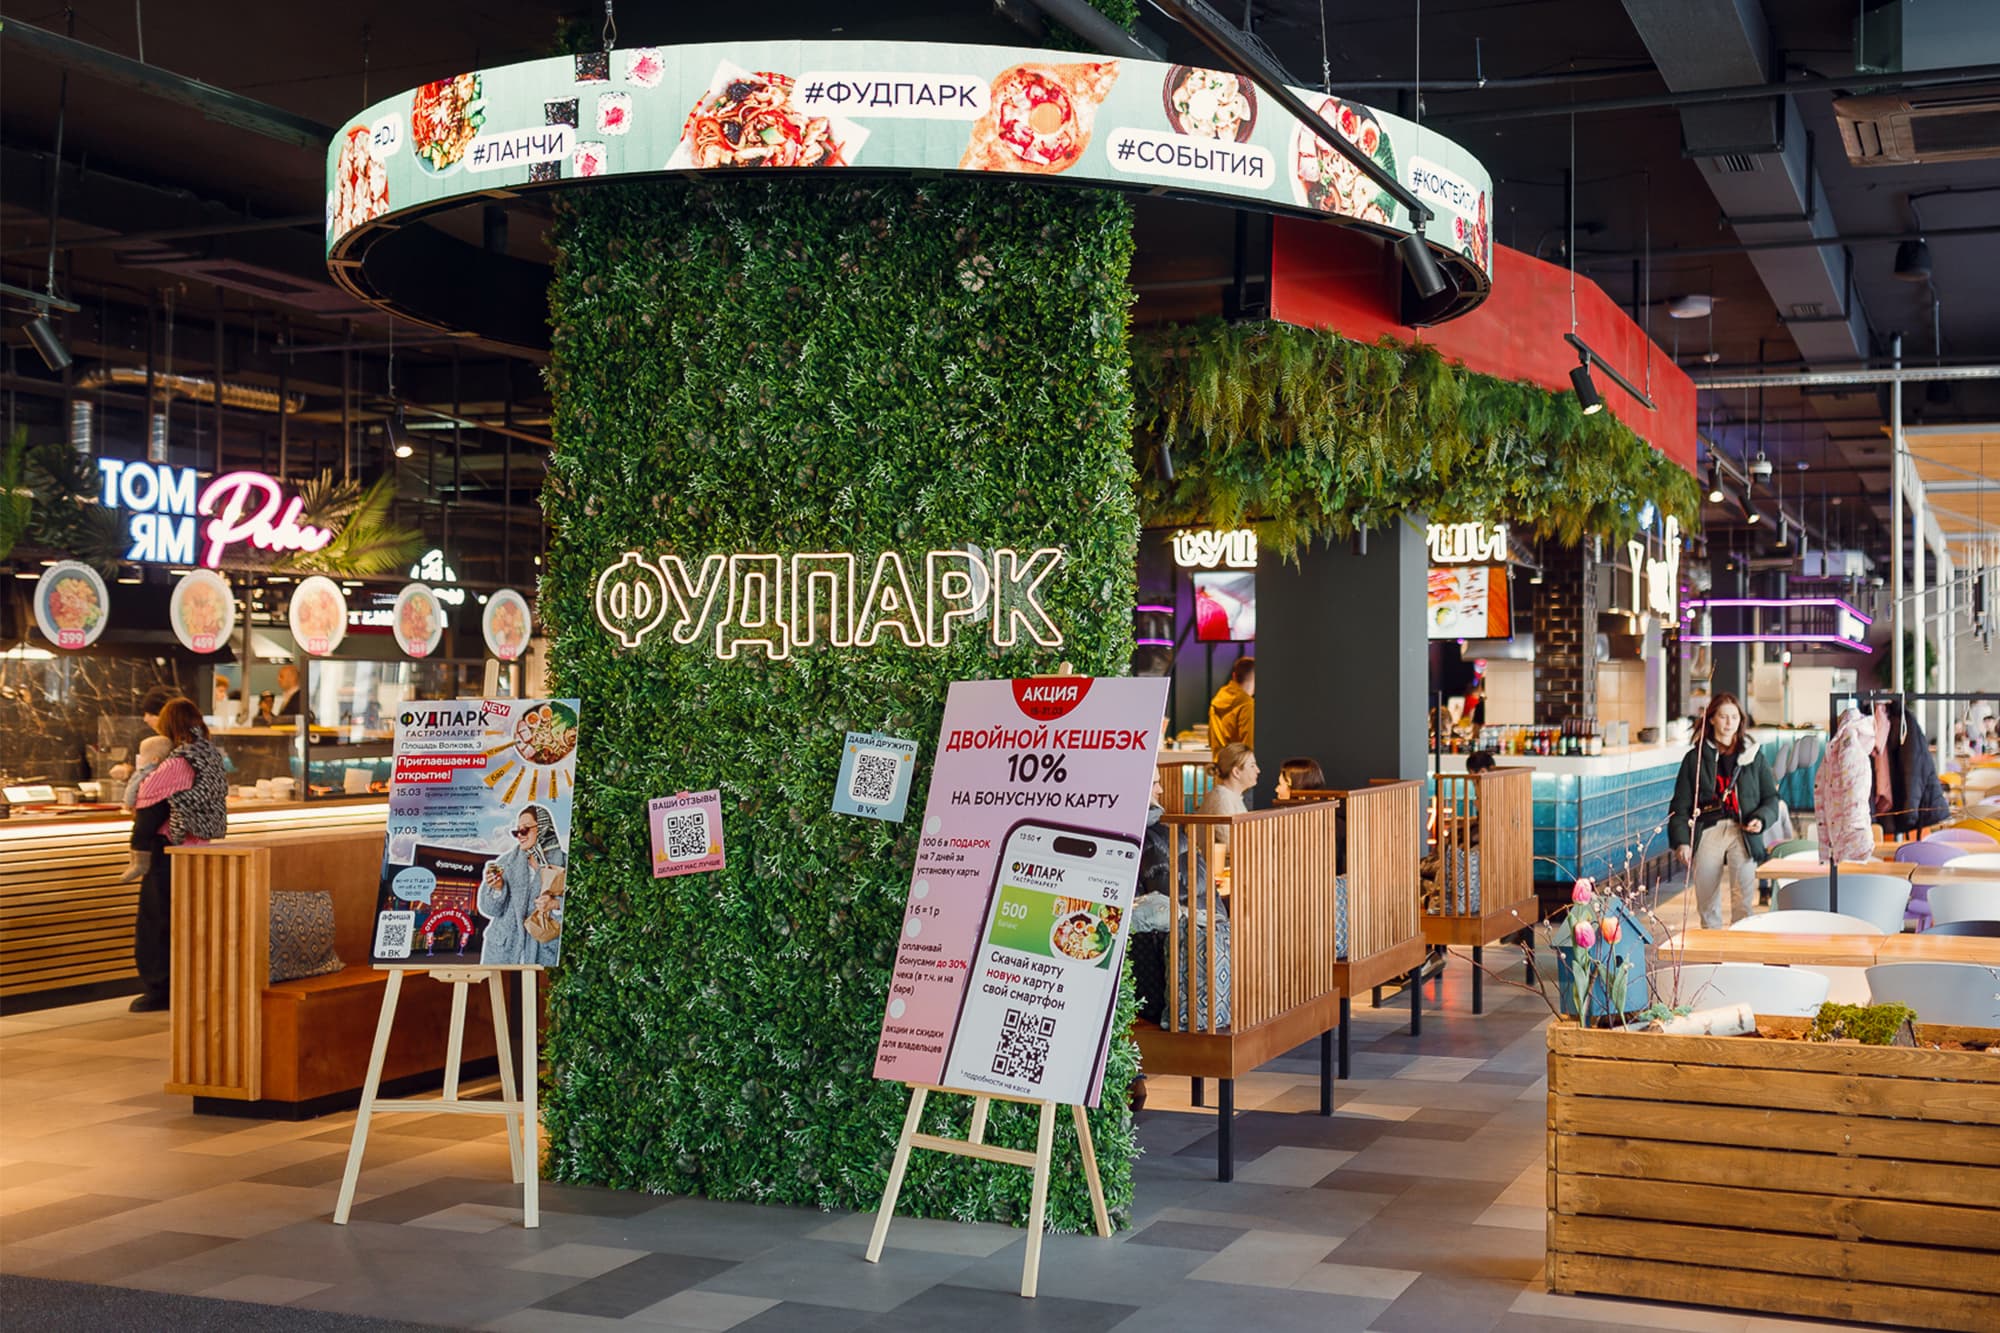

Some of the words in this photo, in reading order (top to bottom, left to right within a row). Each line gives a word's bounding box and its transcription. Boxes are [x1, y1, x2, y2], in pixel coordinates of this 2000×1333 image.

[805, 80, 978, 108] #ФУДПАРК
[375, 123, 396, 146] #DJ
[472, 131, 565, 165] #ЛАНЧИ
[1117, 138, 1264, 178] #СОБЫТИЯ
[98, 457, 196, 516] ТОМ
[126, 513, 196, 565] ЯМ
[595, 547, 1064, 661] ФУДПАРК
[60, 632, 83, 645] 399
[1021, 685, 1078, 703] АКЦИЯ
[482, 701, 511, 717] NEW
[400, 710, 490, 729] ФУДПАРК
[405, 729, 482, 738] ГАСТРОМАРКЕТ
[946, 724, 1048, 752] ДВОЙНОЙ
[1052, 729, 1149, 751] КЕШБЭК
[401, 741, 437, 750] Площадь
[476, 741, 482, 749] 3
[847, 735, 875, 747] ДАВАЙ
[876, 739, 914, 752] ДРУЖИТЬ
[472, 758, 486, 766] на
[1007, 752, 1068, 783] 10%
[397, 769, 452, 783] открытие!
[396, 787, 421, 798] 15.03
[652, 800, 678, 811] ВАШИ
[680, 794, 717, 806] ОТЗЫВЫ
[951, 791, 972, 806] НА
[974, 791, 1061, 807] БОНУСНУЮ
[1064, 793, 1119, 809] КАРТУ
[394, 807, 420, 817] 16.03
[857, 805, 864, 813] В
[865, 807, 878, 815] VK
[393, 826, 418, 835] 17.03
[922, 838, 936, 847] 100
[949, 838, 991, 849] ПОДАРОК
[930, 852, 935, 860] 7
[936, 852, 954, 861] дней
[657, 864, 683, 874] ДЕЛАЮТ
[917, 867, 955, 877] установку
[956, 868, 980, 878] карты
[1011, 861, 1065, 882] ФУДПАРК
[1012, 875, 1058, 889] ГАСТРОМАРКЕТ
[1102, 886, 1119, 900] 5%
[382, 912, 411, 922] афиша
[1001, 901, 1028, 919] 500
[388, 948, 401, 957] ВК
[902, 943, 942, 952] оплачивай
[899, 955, 936, 967] бонусами
[936, 960, 947, 969] до
[948, 960, 967, 970] 30%
[991, 951, 1029, 969] Скачай
[1031, 961, 1064, 979] карту
[896, 971, 913, 980] чека
[944, 975, 954, 983] на
[986, 968, 1021, 984] новую
[1022, 975, 1055, 993] карту
[1056, 983, 1064, 993] в
[893, 984, 915, 996] баре)
[982, 983, 1008, 997] свой
[1009, 989, 1065, 1010] смартфон
[885, 1025, 908, 1035] акции
[915, 1028, 944, 1038] скидки
[882, 1040, 896, 1049] для
[897, 1041, 942, 1053] владельцев
[879, 1054, 897, 1064] карт
[963, 1071, 1003, 1087] подробности
[1013, 1085, 1031, 1095] кассе
